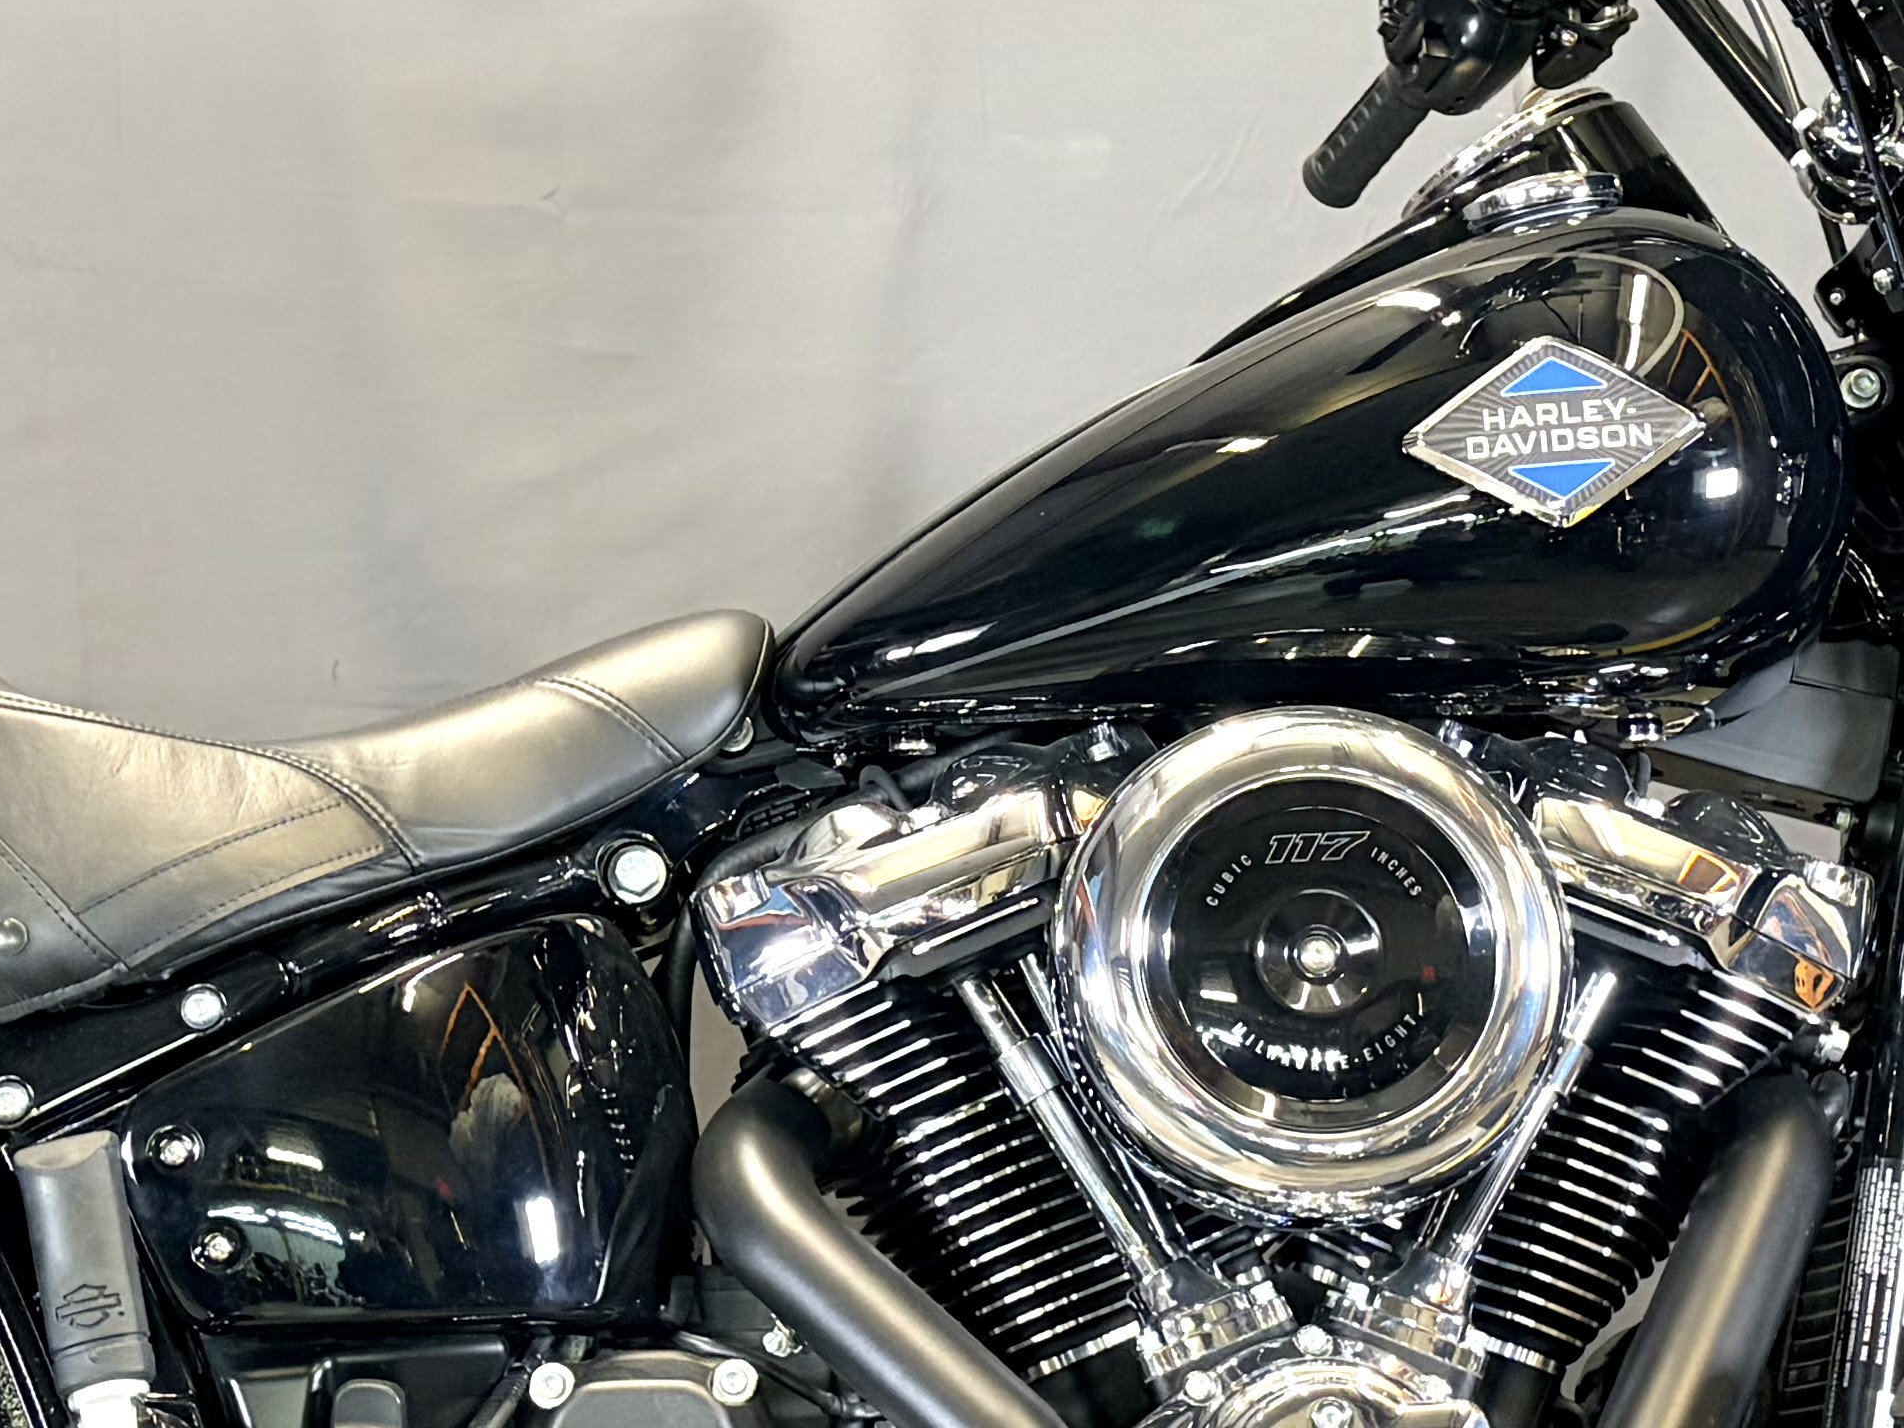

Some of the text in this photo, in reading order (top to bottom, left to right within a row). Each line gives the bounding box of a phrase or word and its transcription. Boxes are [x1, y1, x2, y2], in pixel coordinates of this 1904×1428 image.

[1483, 397, 1637, 431] HARLEY-
[1465, 422, 1653, 460] DAVIDSON
[1205, 830, 1423, 907] CUBIC 117 INCHES
